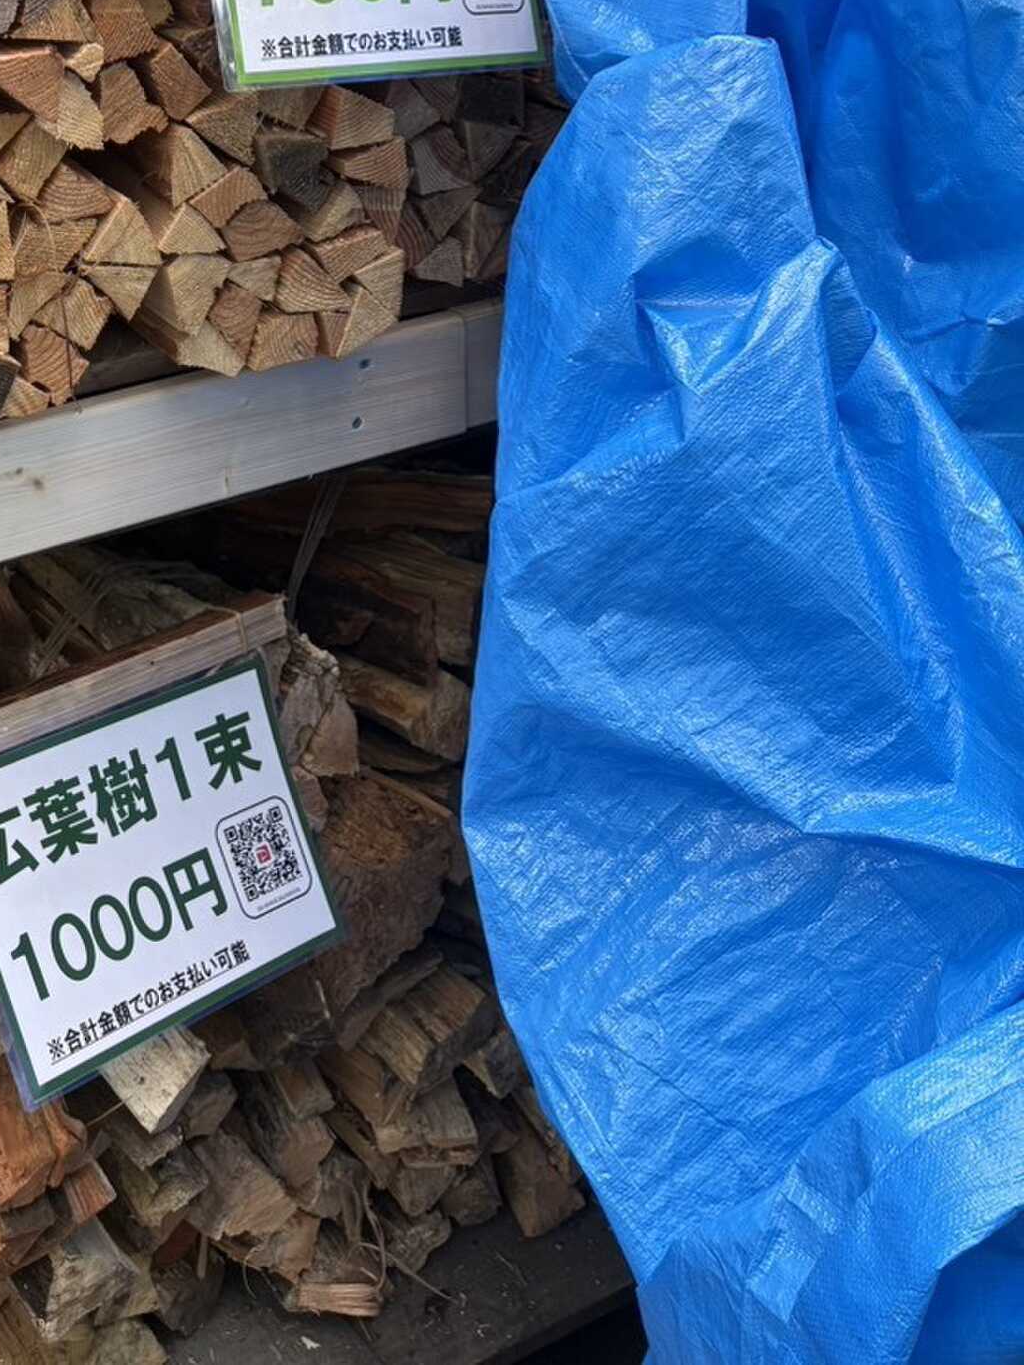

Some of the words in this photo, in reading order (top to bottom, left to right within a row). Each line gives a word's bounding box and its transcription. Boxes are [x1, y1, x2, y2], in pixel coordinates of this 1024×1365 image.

[261, 26, 464, 59] ※合計金額でのお支払い可能
[10, 847, 229, 1001] 1000円
[48, 939, 251, 1060] ※合計金額でのお支払い可能
